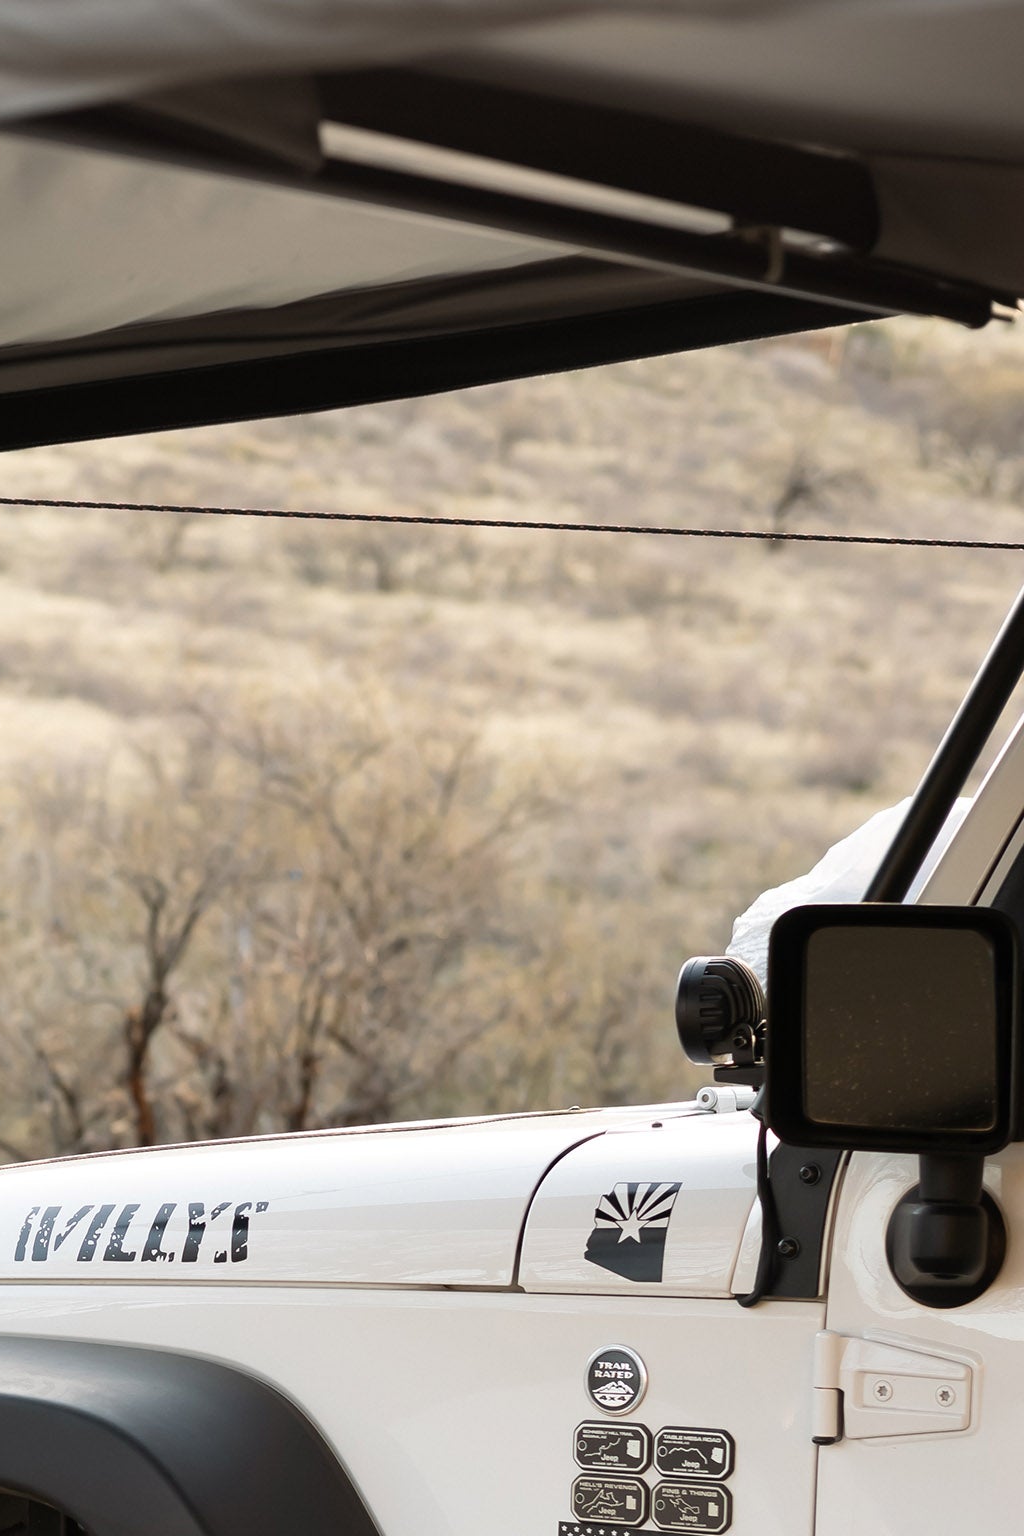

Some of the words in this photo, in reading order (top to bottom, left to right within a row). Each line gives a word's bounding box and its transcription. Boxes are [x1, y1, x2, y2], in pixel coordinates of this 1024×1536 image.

[13, 1201, 270, 1263] WILLYS
[597, 1361, 632, 1371] TRAIL
[594, 1369, 634, 1379] RATED
[600, 1453, 619, 1463] Jeep
[681, 1459, 701, 1469] Jeep
[598, 1506, 617, 1516] Jeep
[679, 1513, 698, 1523] Jeep
